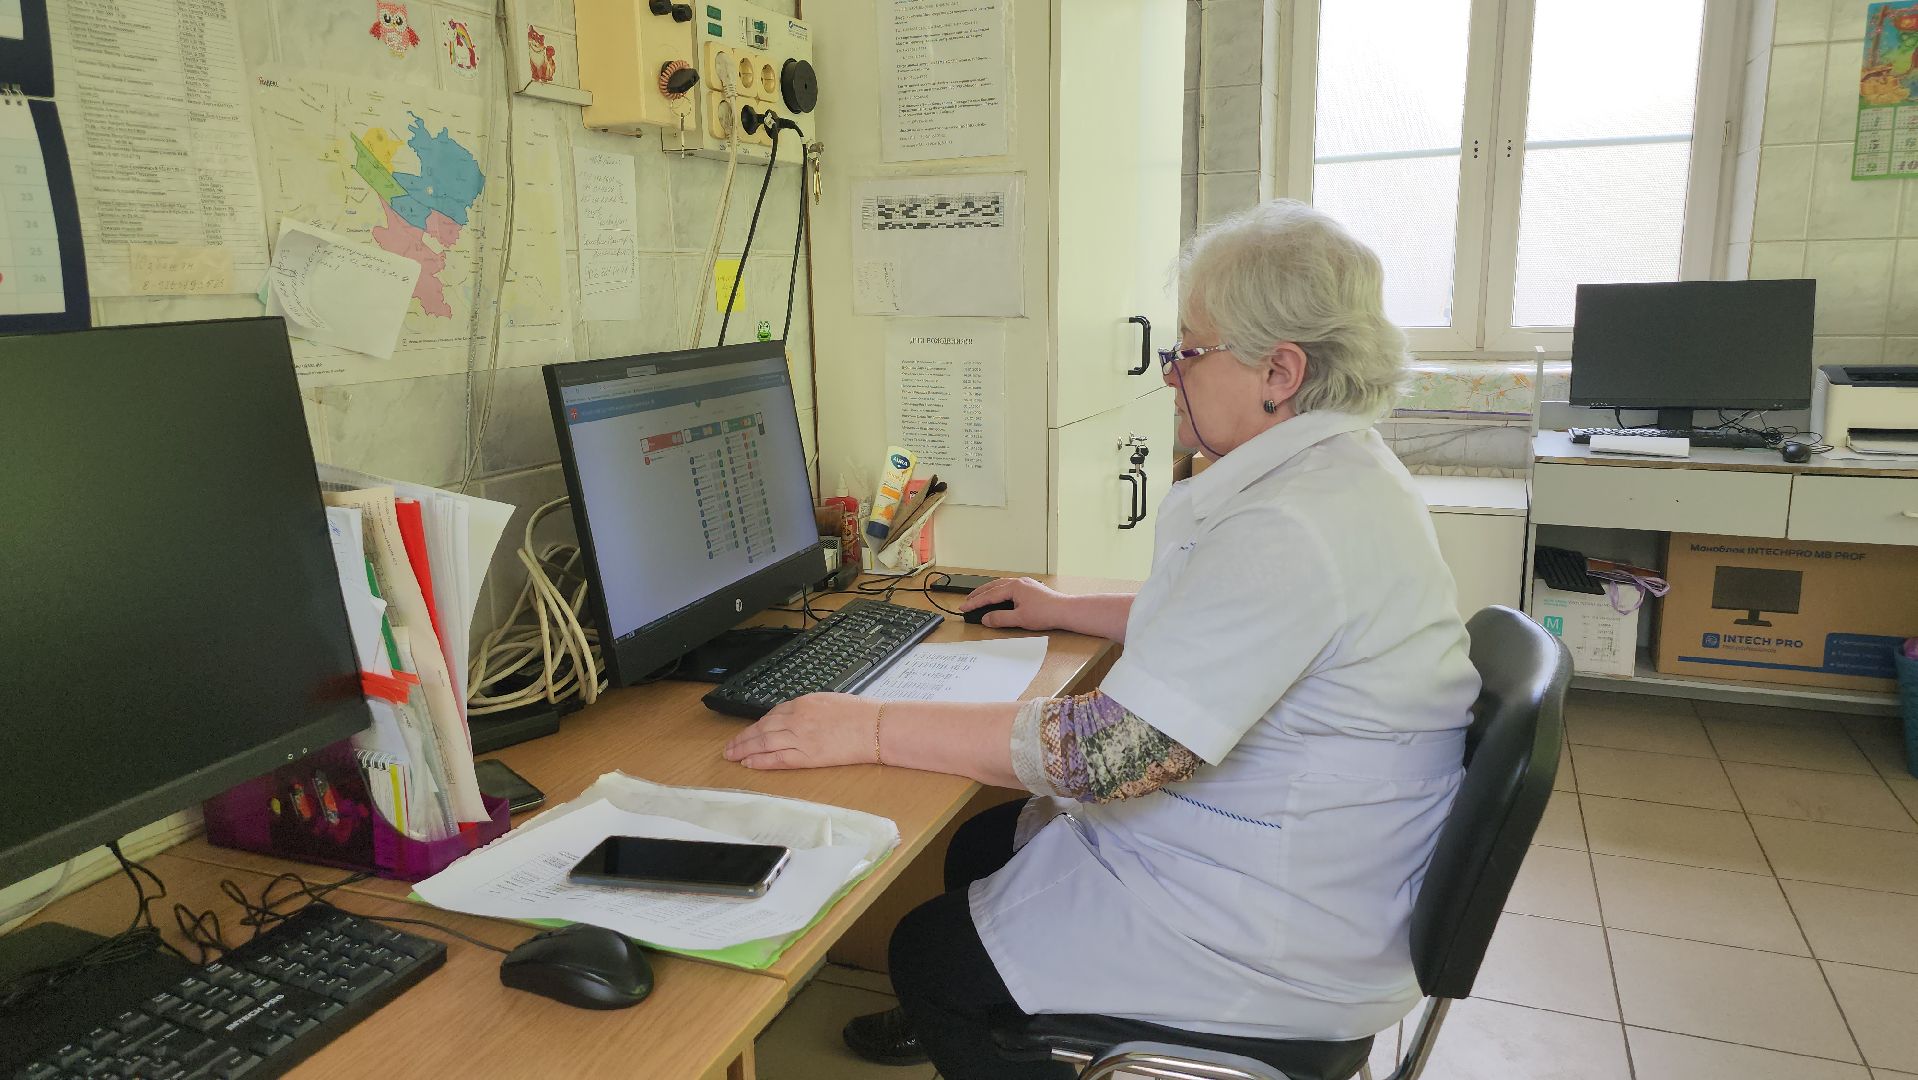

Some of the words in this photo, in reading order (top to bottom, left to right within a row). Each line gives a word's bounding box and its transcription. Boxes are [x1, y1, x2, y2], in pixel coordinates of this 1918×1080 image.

[893, 456, 908, 467] AURA
[1690, 543, 1745, 554] Моноблок
[1747, 545, 1812, 558] INTECHPRO
[1814, 550, 1832, 560] MB
[1834, 551, 1867, 561] PROF
[1723, 634, 1771, 646] INTECH
[1775, 638, 1804, 649] PRO
[225, 1006, 263, 1031] INTECH
[262, 994, 285, 1008] PRO
